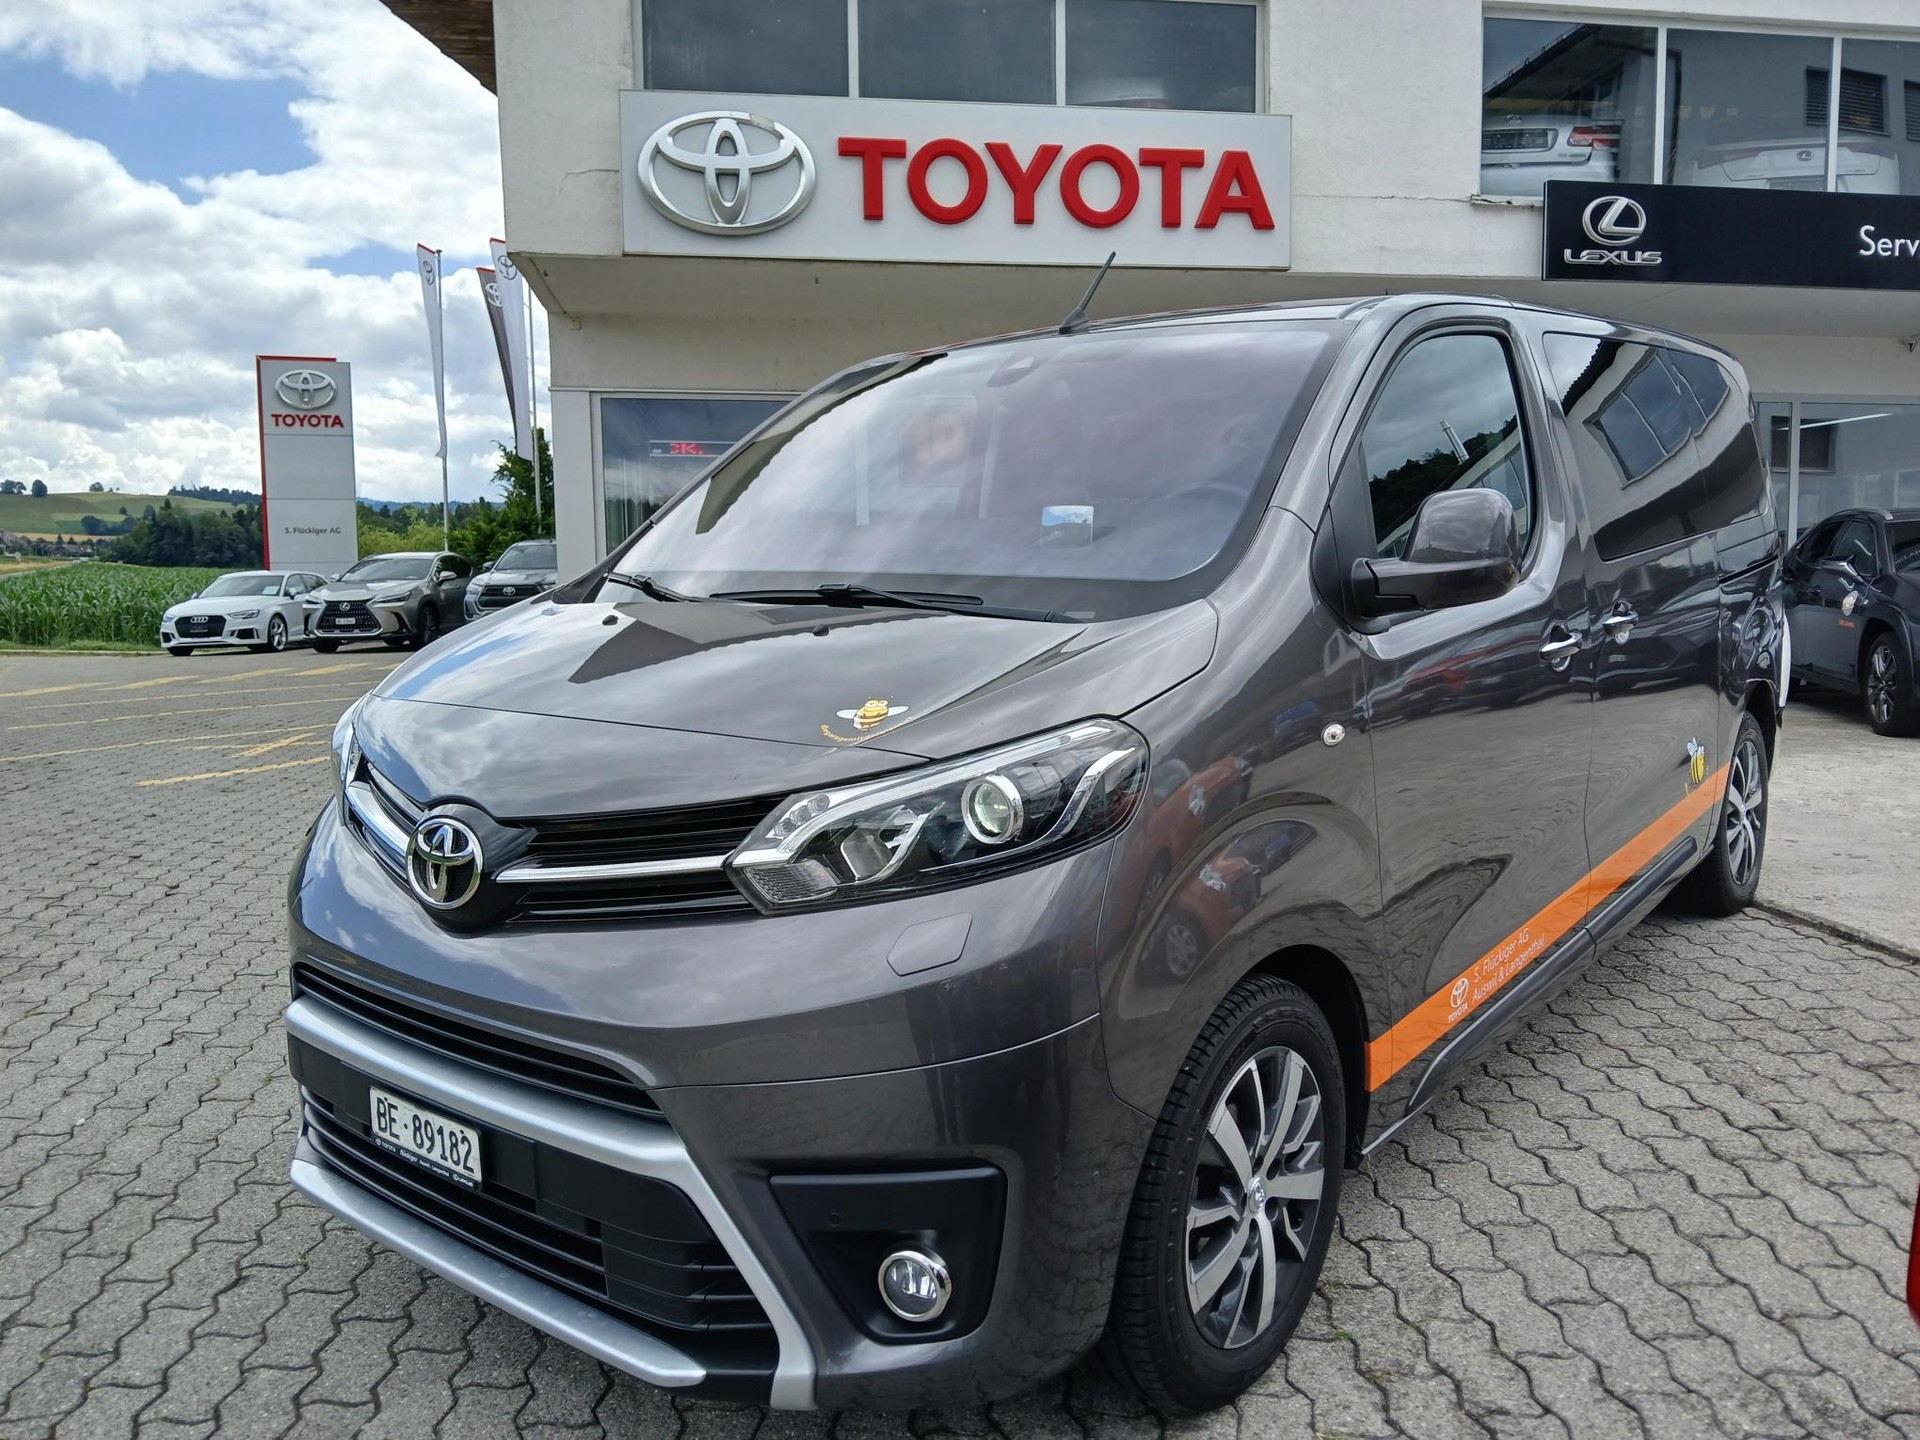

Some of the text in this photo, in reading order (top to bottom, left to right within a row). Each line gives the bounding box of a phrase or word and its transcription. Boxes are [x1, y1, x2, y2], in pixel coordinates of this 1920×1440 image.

[838, 136, 1275, 231] TOYOTA
[1564, 248, 1662, 266] LEXUS
[270, 413, 345, 428] TOYOTA
[1447, 1002, 1469, 1024] TOYOTA
